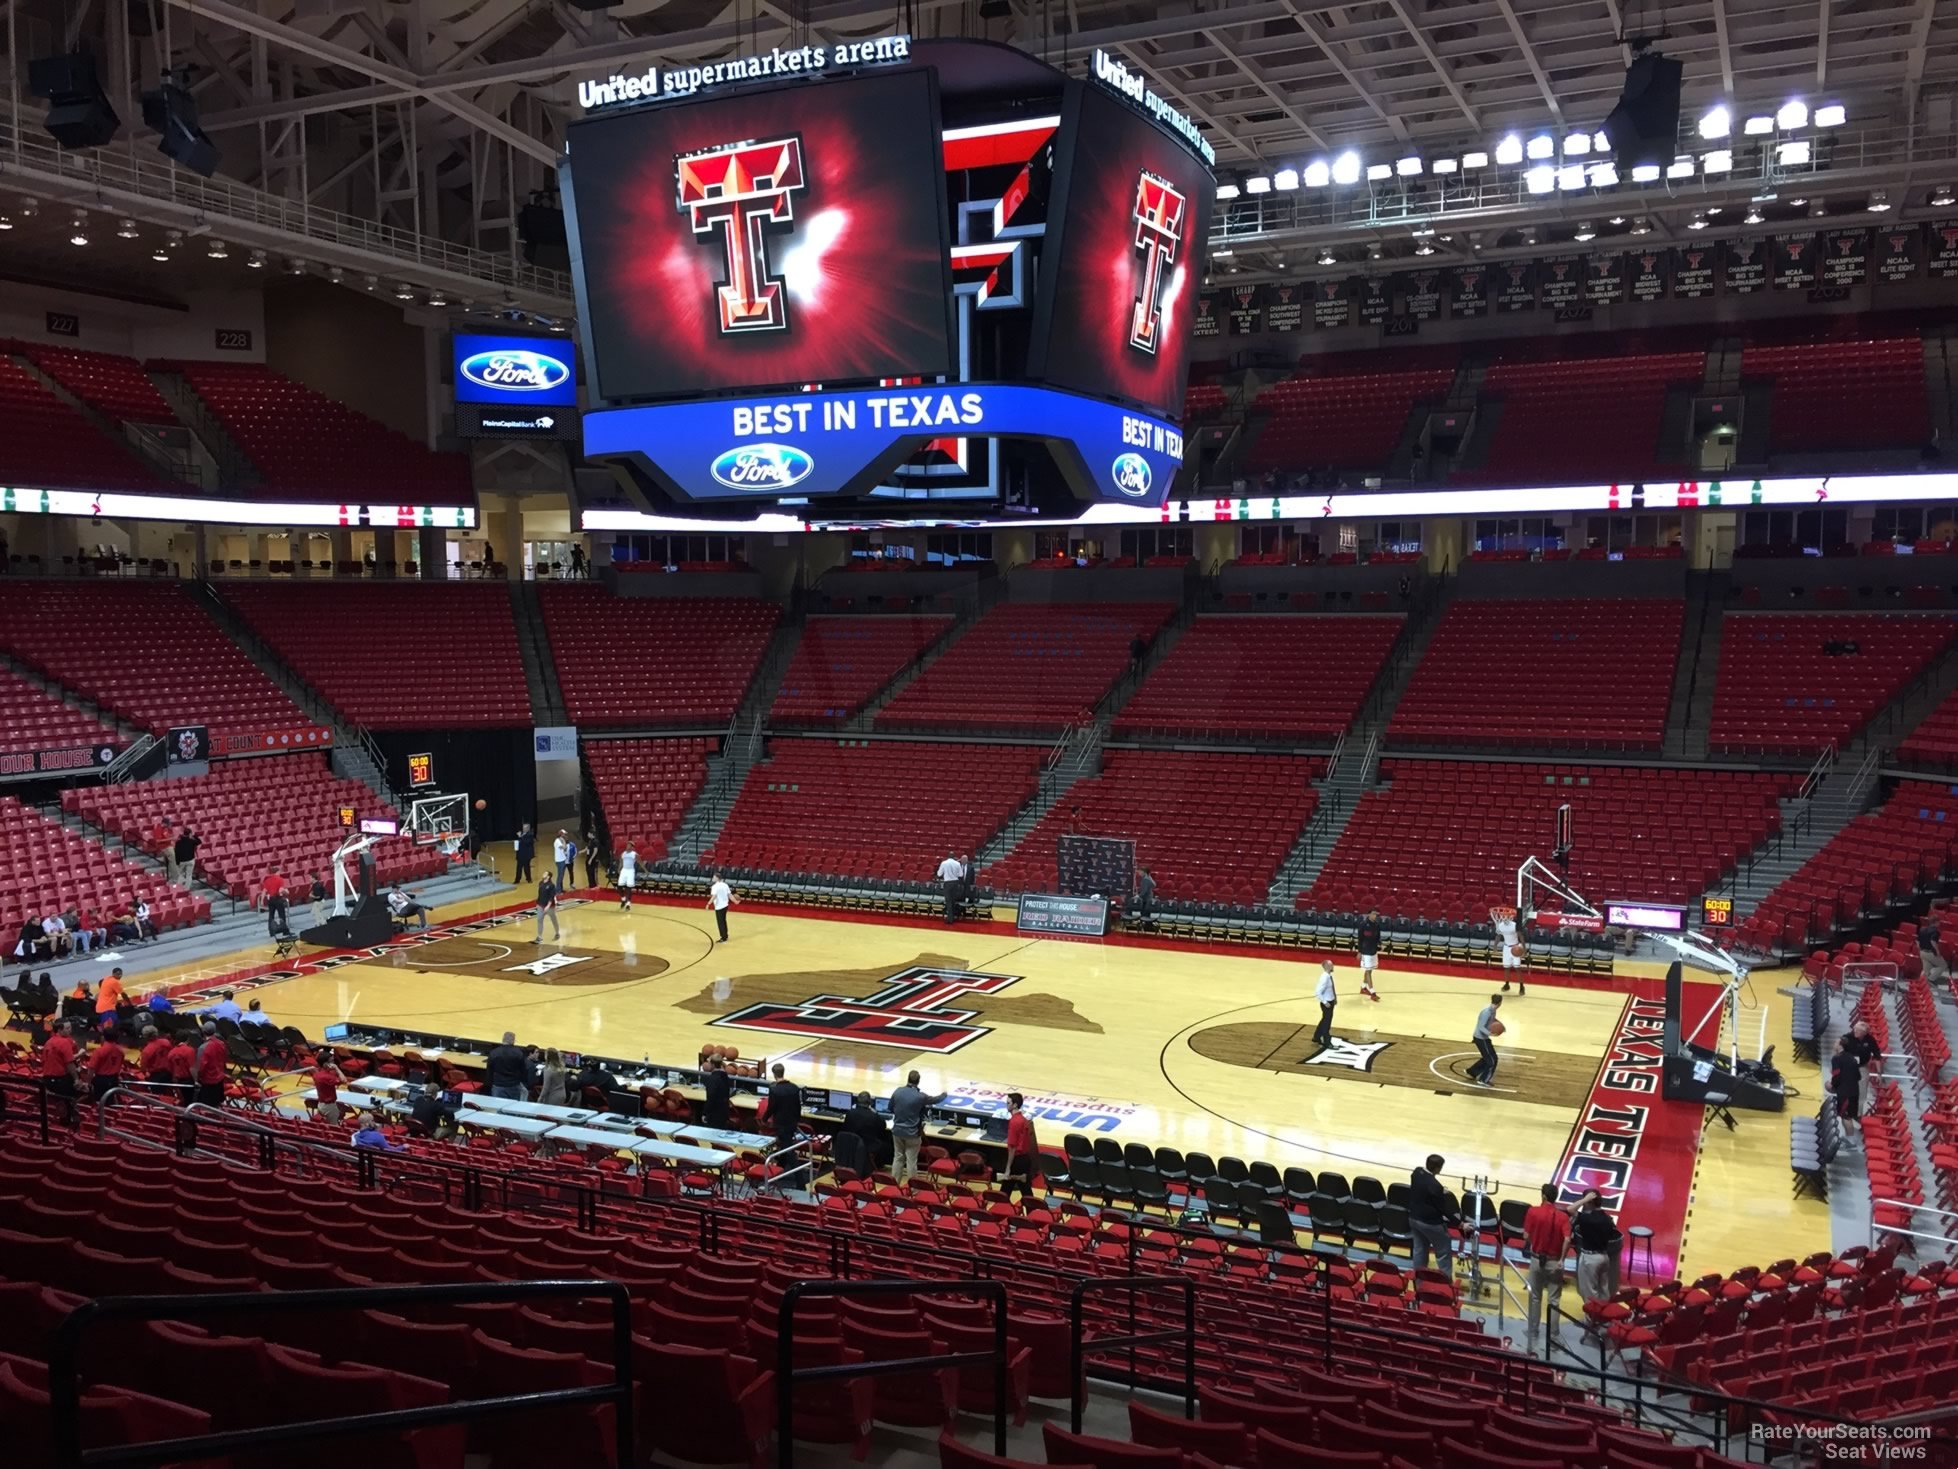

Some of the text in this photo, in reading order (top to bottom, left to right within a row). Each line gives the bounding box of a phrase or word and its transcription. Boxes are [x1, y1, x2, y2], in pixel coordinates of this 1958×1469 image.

[578, 35, 908, 108] United supermarkets arena
[1096, 48, 1144, 102] United
[1145, 90, 1200, 148] supermarkets
[1826, 256, 1865, 265] CHAMPIONS
[1824, 269, 1865, 279] CONFERENCE
[52, 318, 74, 332] 227
[220, 332, 247, 346] 228
[483, 354, 548, 384] Ford
[733, 393, 983, 436] BEST IN TEXAS
[1123, 416, 1152, 448] BEST
[1154, 426, 1164, 452] IN
[730, 450, 793, 482] Ford
[1120, 458, 1146, 490] Ford
[226, 734, 261, 750] COUNT
[0, 748, 94, 774] OUR HOUSE
[410, 756, 428, 767] 60:00
[413, 766, 427, 782] 30
[342, 816, 351, 825] 30
[1025, 900, 1048, 909] PROTECT
[1705, 900, 1731, 911] 60:00
[1022, 912, 1048, 921] RED
[1710, 911, 1726, 923] 30
[1032, 921, 1089, 930] BASKETBALL
[1600, 996, 1666, 1094] TEXAS
